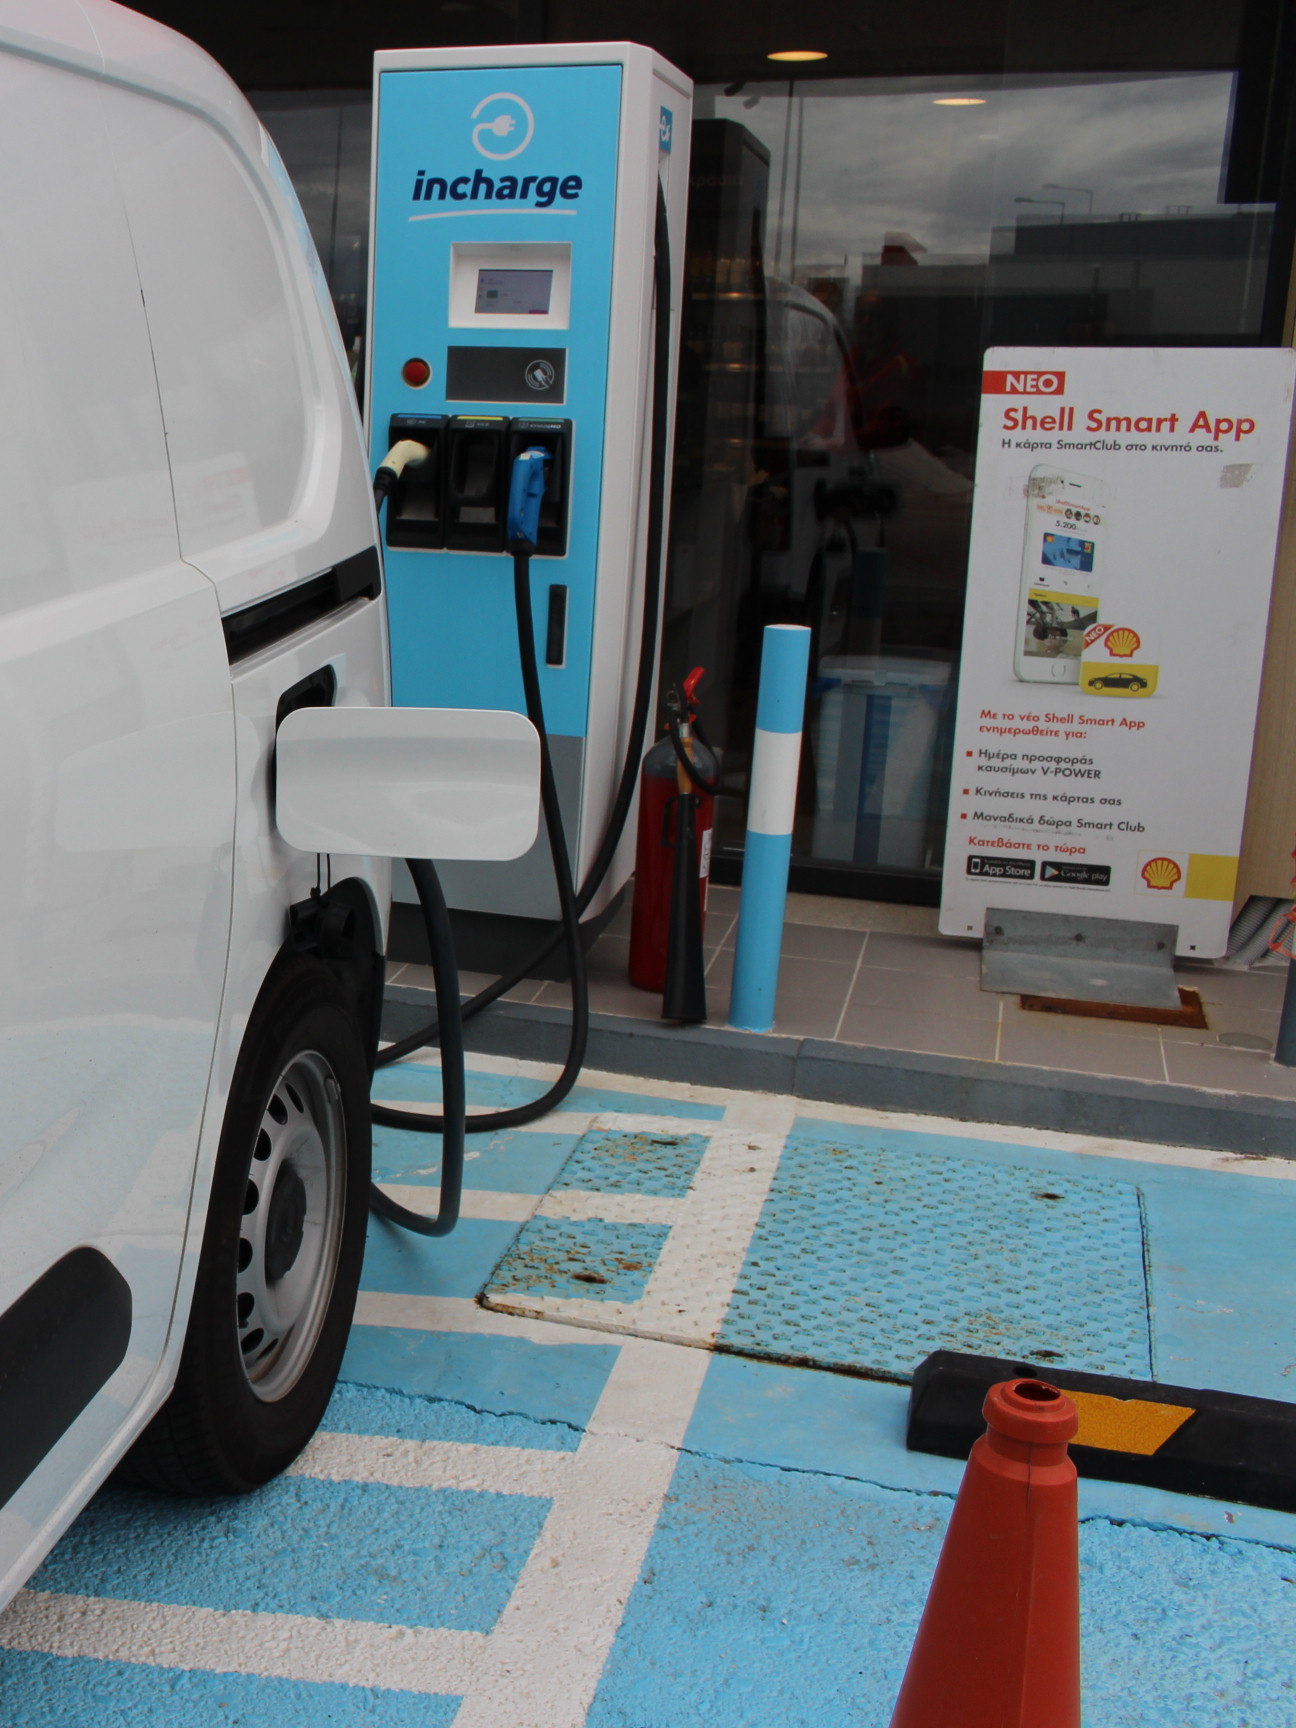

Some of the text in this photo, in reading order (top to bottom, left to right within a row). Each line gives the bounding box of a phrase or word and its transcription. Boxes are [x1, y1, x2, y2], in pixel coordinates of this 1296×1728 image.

[412, 169, 583, 208] incharge
[1005, 374, 1058, 393] ΝΕΟ
[1002, 406, 1256, 442] Shell Smart App
[1001, 438, 1224, 453] Η κάρτα SmartClub στο κινητό σας.
[1085, 626, 1104, 643] ΝΕΟ
[980, 709, 1146, 730] Με το νέο Shell Smart App
[979, 725, 1088, 740] ενημερωθείτε για:
[978, 749, 1094, 766] Ημέρα προσφοράς
[977, 764, 1102, 779] καυσίμων V-POWER
[975, 786, 1122, 806] Κινήσεις της κάρτας σας
[972, 811, 1034, 825] Μοναδικά
[1038, 815, 1072, 829] δώρα
[1076, 818, 1113, 830] Smart
[1117, 821, 1146, 832] Club
[968, 835, 1086, 856] Κατεβάστε το τώρα
[982, 863, 1004, 876] App
[1005, 865, 1031, 877] Store
[1060, 871, 1108, 882] Google play
